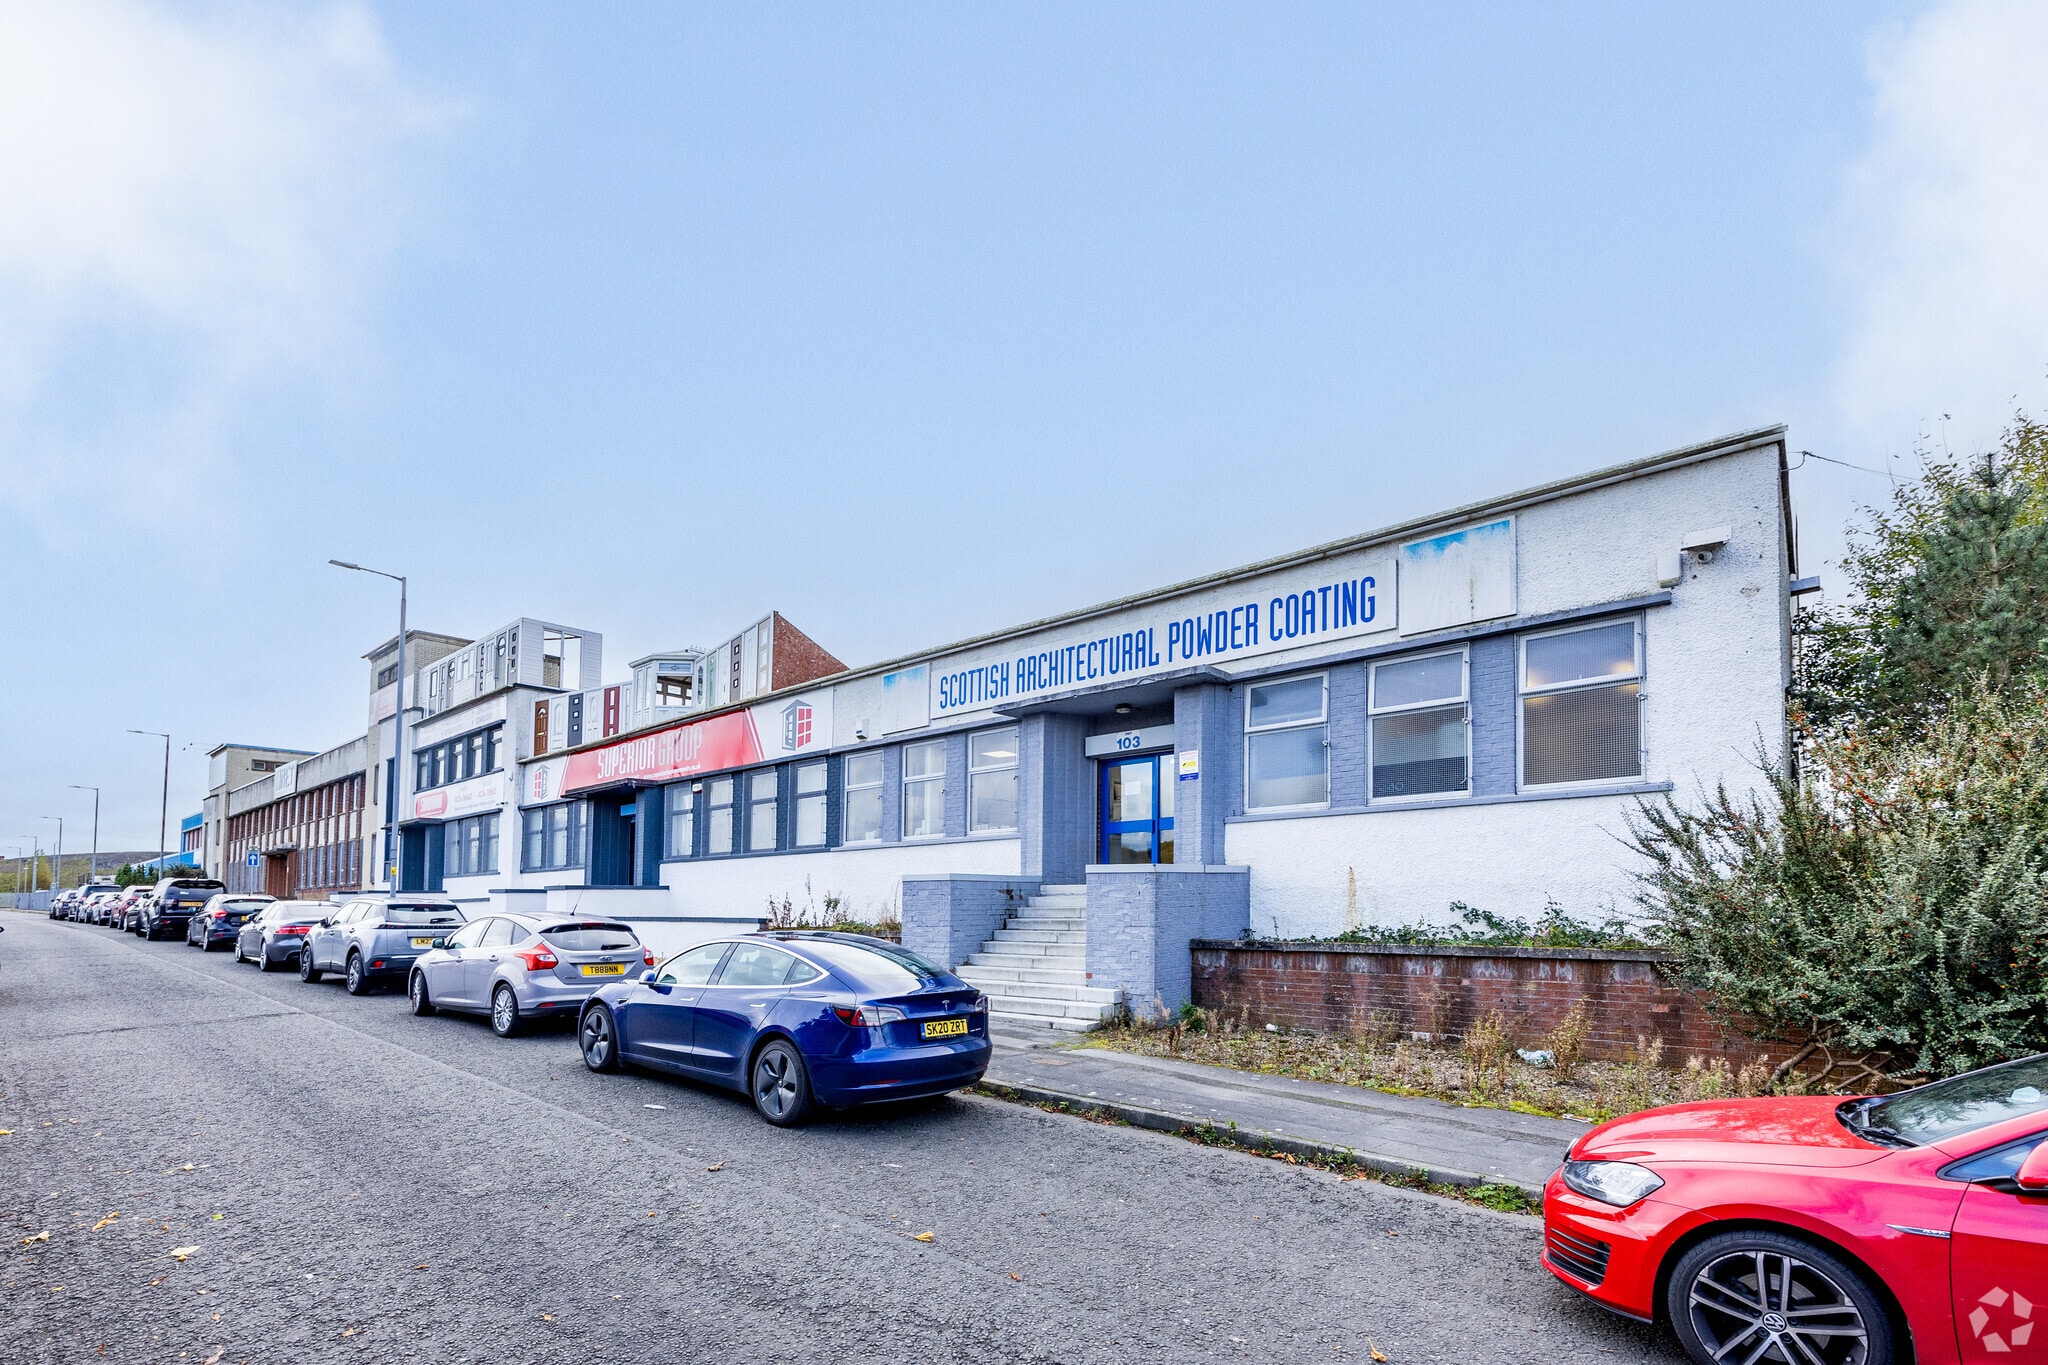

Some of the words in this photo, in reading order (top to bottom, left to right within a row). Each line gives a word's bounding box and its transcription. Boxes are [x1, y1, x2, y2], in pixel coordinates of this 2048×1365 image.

[940, 661, 1010, 710] SCOTTISH
[1016, 627, 1160, 694] ARCHITECTURAL
[1168, 602, 1259, 663] POWDER
[1269, 576, 1376, 642] COATING
[597, 737, 656, 779] SUPERIOR
[657, 726, 703, 766] GROUP
[1116, 735, 1141, 750] 103
[926, 1021, 948, 1036] SK20
[950, 1020, 966, 1033] ZRT
